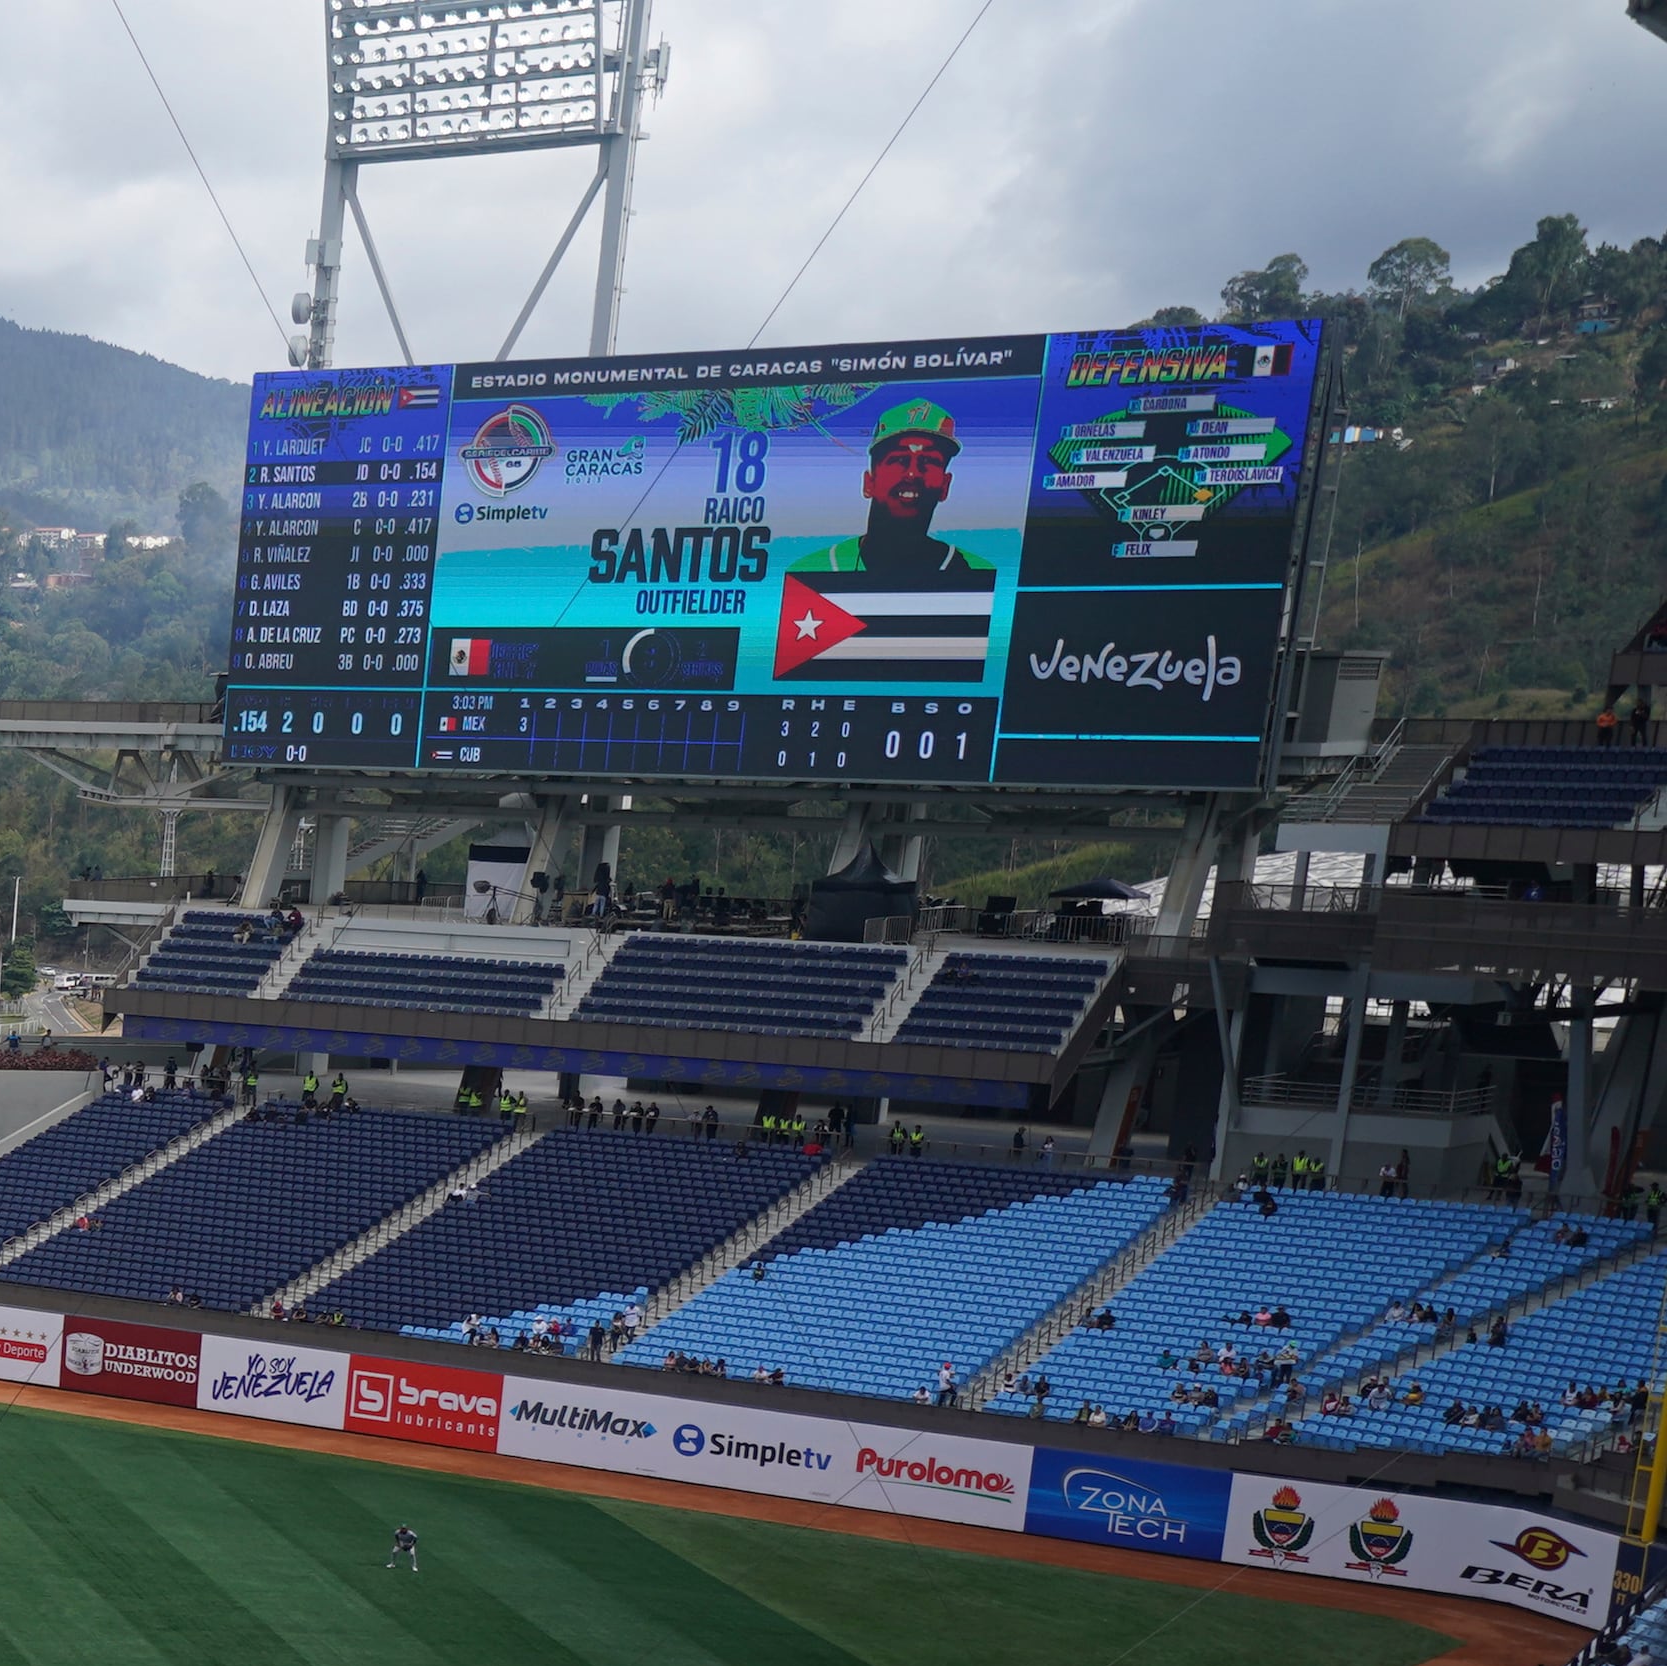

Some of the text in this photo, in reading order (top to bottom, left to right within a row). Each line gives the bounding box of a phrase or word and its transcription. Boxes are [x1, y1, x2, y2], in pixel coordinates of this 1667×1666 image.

[471, 347, 1013, 388] ESTADIO MONUMENTAL DE CARACAS "SIMÓN BOLÍVAR"
[1067, 346, 1228, 387] DEFENSIVA
[1142, 398, 1187, 411] CARDONA
[1075, 424, 1116, 437] ORNELAS
[1201, 421, 1229, 434] DEAN
[263, 435, 439, 455] Y. LARDUET .417
[1085, 447, 1144, 461] VALENZUELA
[1192, 446, 1230, 459] ATONDO
[567, 450, 613, 462] GRAN
[712, 432, 769, 494] 18
[260, 462, 437, 483] R. SANTOS .154
[566, 462, 643, 476] CARACAS
[1056, 475, 1096, 487] AMADOR
[258, 490, 434, 509] Y. ALARCON .231
[477, 506, 548, 523] Simpletv
[704, 497, 765, 524] RAICO
[1133, 507, 1166, 520] KINLEY
[256, 517, 432, 536] Y. ALARCON .417
[253, 544, 429, 563] R. VIÑALEZ .000
[589, 527, 771, 584] SANTOS
[1125, 544, 1151, 556] FELIX
[250, 573, 426, 590] G. AVILES .333
[249, 600, 424, 617] D. LAZA .375
[636, 590, 746, 615] OUTFIELDER
[246, 627, 422, 644] A. DE LA CRUZ .273
[244, 653, 418, 671] O. ABREU .000
[452, 696, 494, 710] 3:03 PM
[233, 710, 268, 732] .154
[462, 716, 486, 731] MEX
[459, 747, 481, 762] CUB
[3, 1343, 45, 1361] Deporte
[104, 1343, 198, 1369] DIABLITOS
[104, 1359, 198, 1384] UNDERWOOD
[248, 1354, 296, 1376] YO SOY
[212, 1370, 335, 1403] VENEZUELA
[399, 1378, 497, 1417] brava
[396, 1411, 495, 1438] lubricants
[516, 1399, 646, 1439] MultiMax
[709, 1432, 832, 1471] Simpletv
[856, 1446, 1005, 1494] Purolomo
[1078, 1486, 1167, 1517] ZONA
[1104, 1511, 1186, 1543] TECH
[1459, 1565, 1589, 1609] BERA
[1614, 1570, 1640, 1594] 330
[1528, 1593, 1587, 1615] MOTORCYCLES
